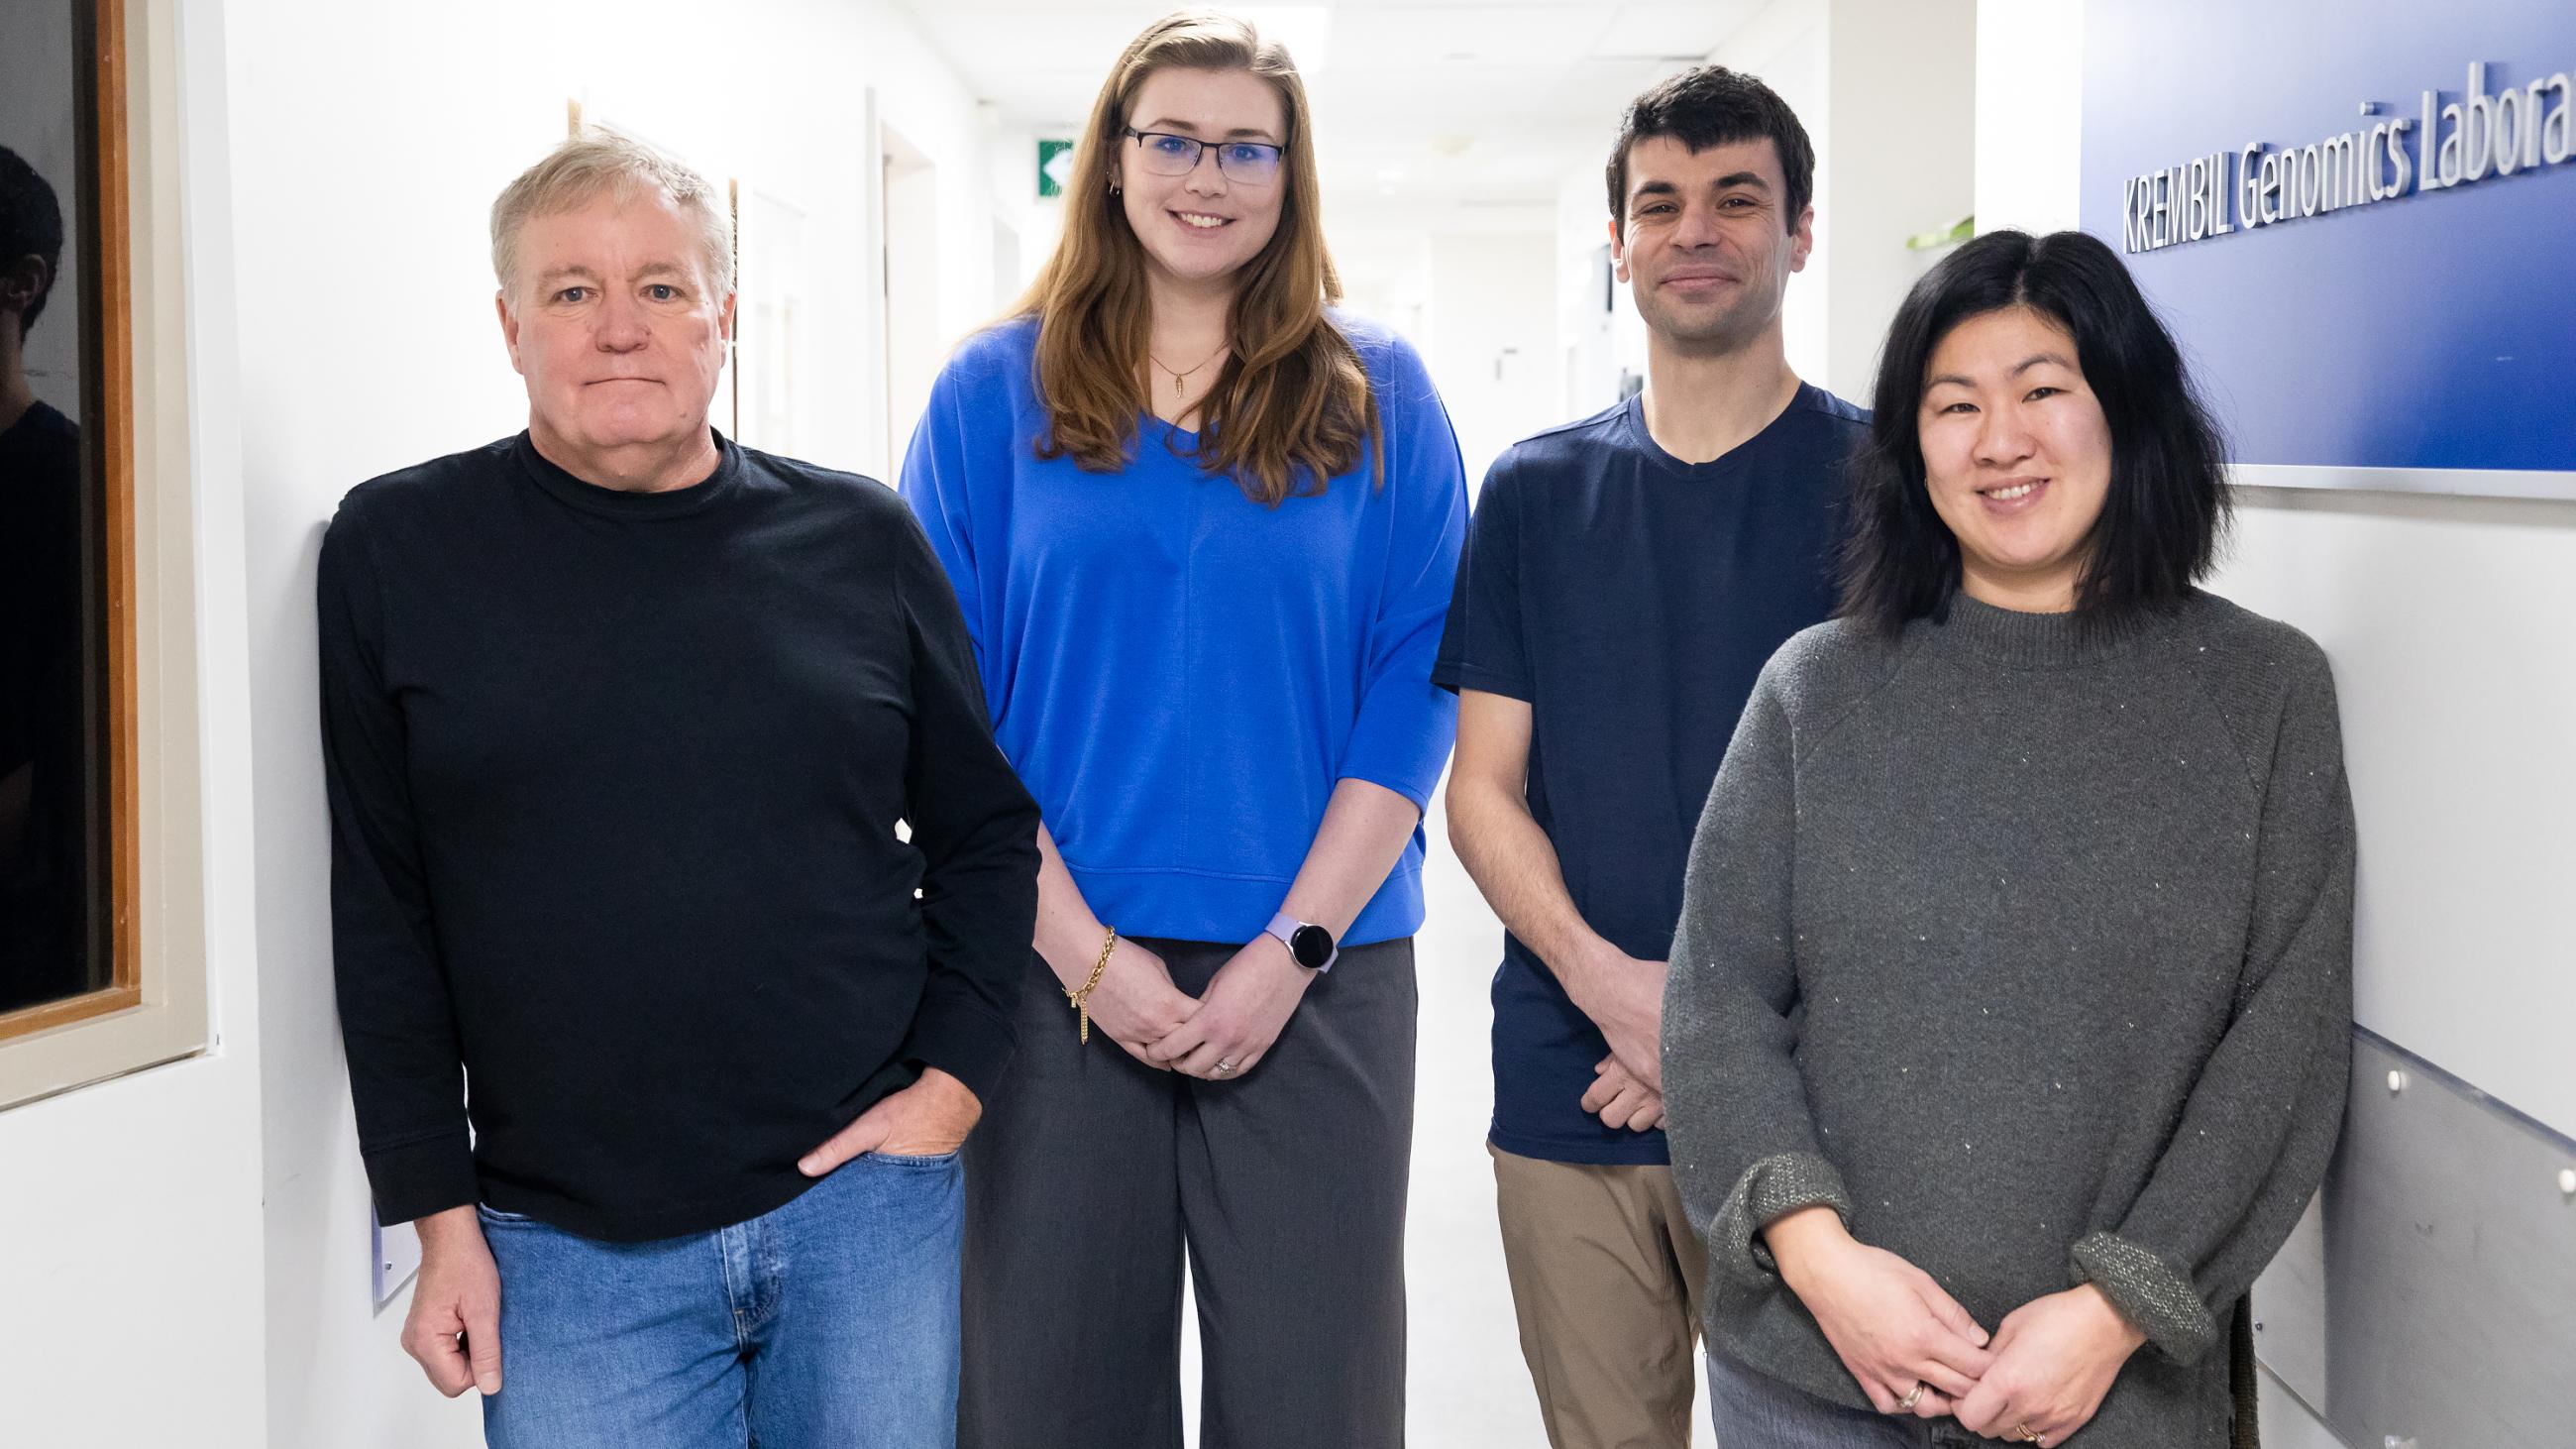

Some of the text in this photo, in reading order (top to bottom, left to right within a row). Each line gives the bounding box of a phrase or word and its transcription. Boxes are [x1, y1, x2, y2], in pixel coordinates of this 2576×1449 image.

[2123, 60, 2576, 254] KREMBIL Genomics Labora
